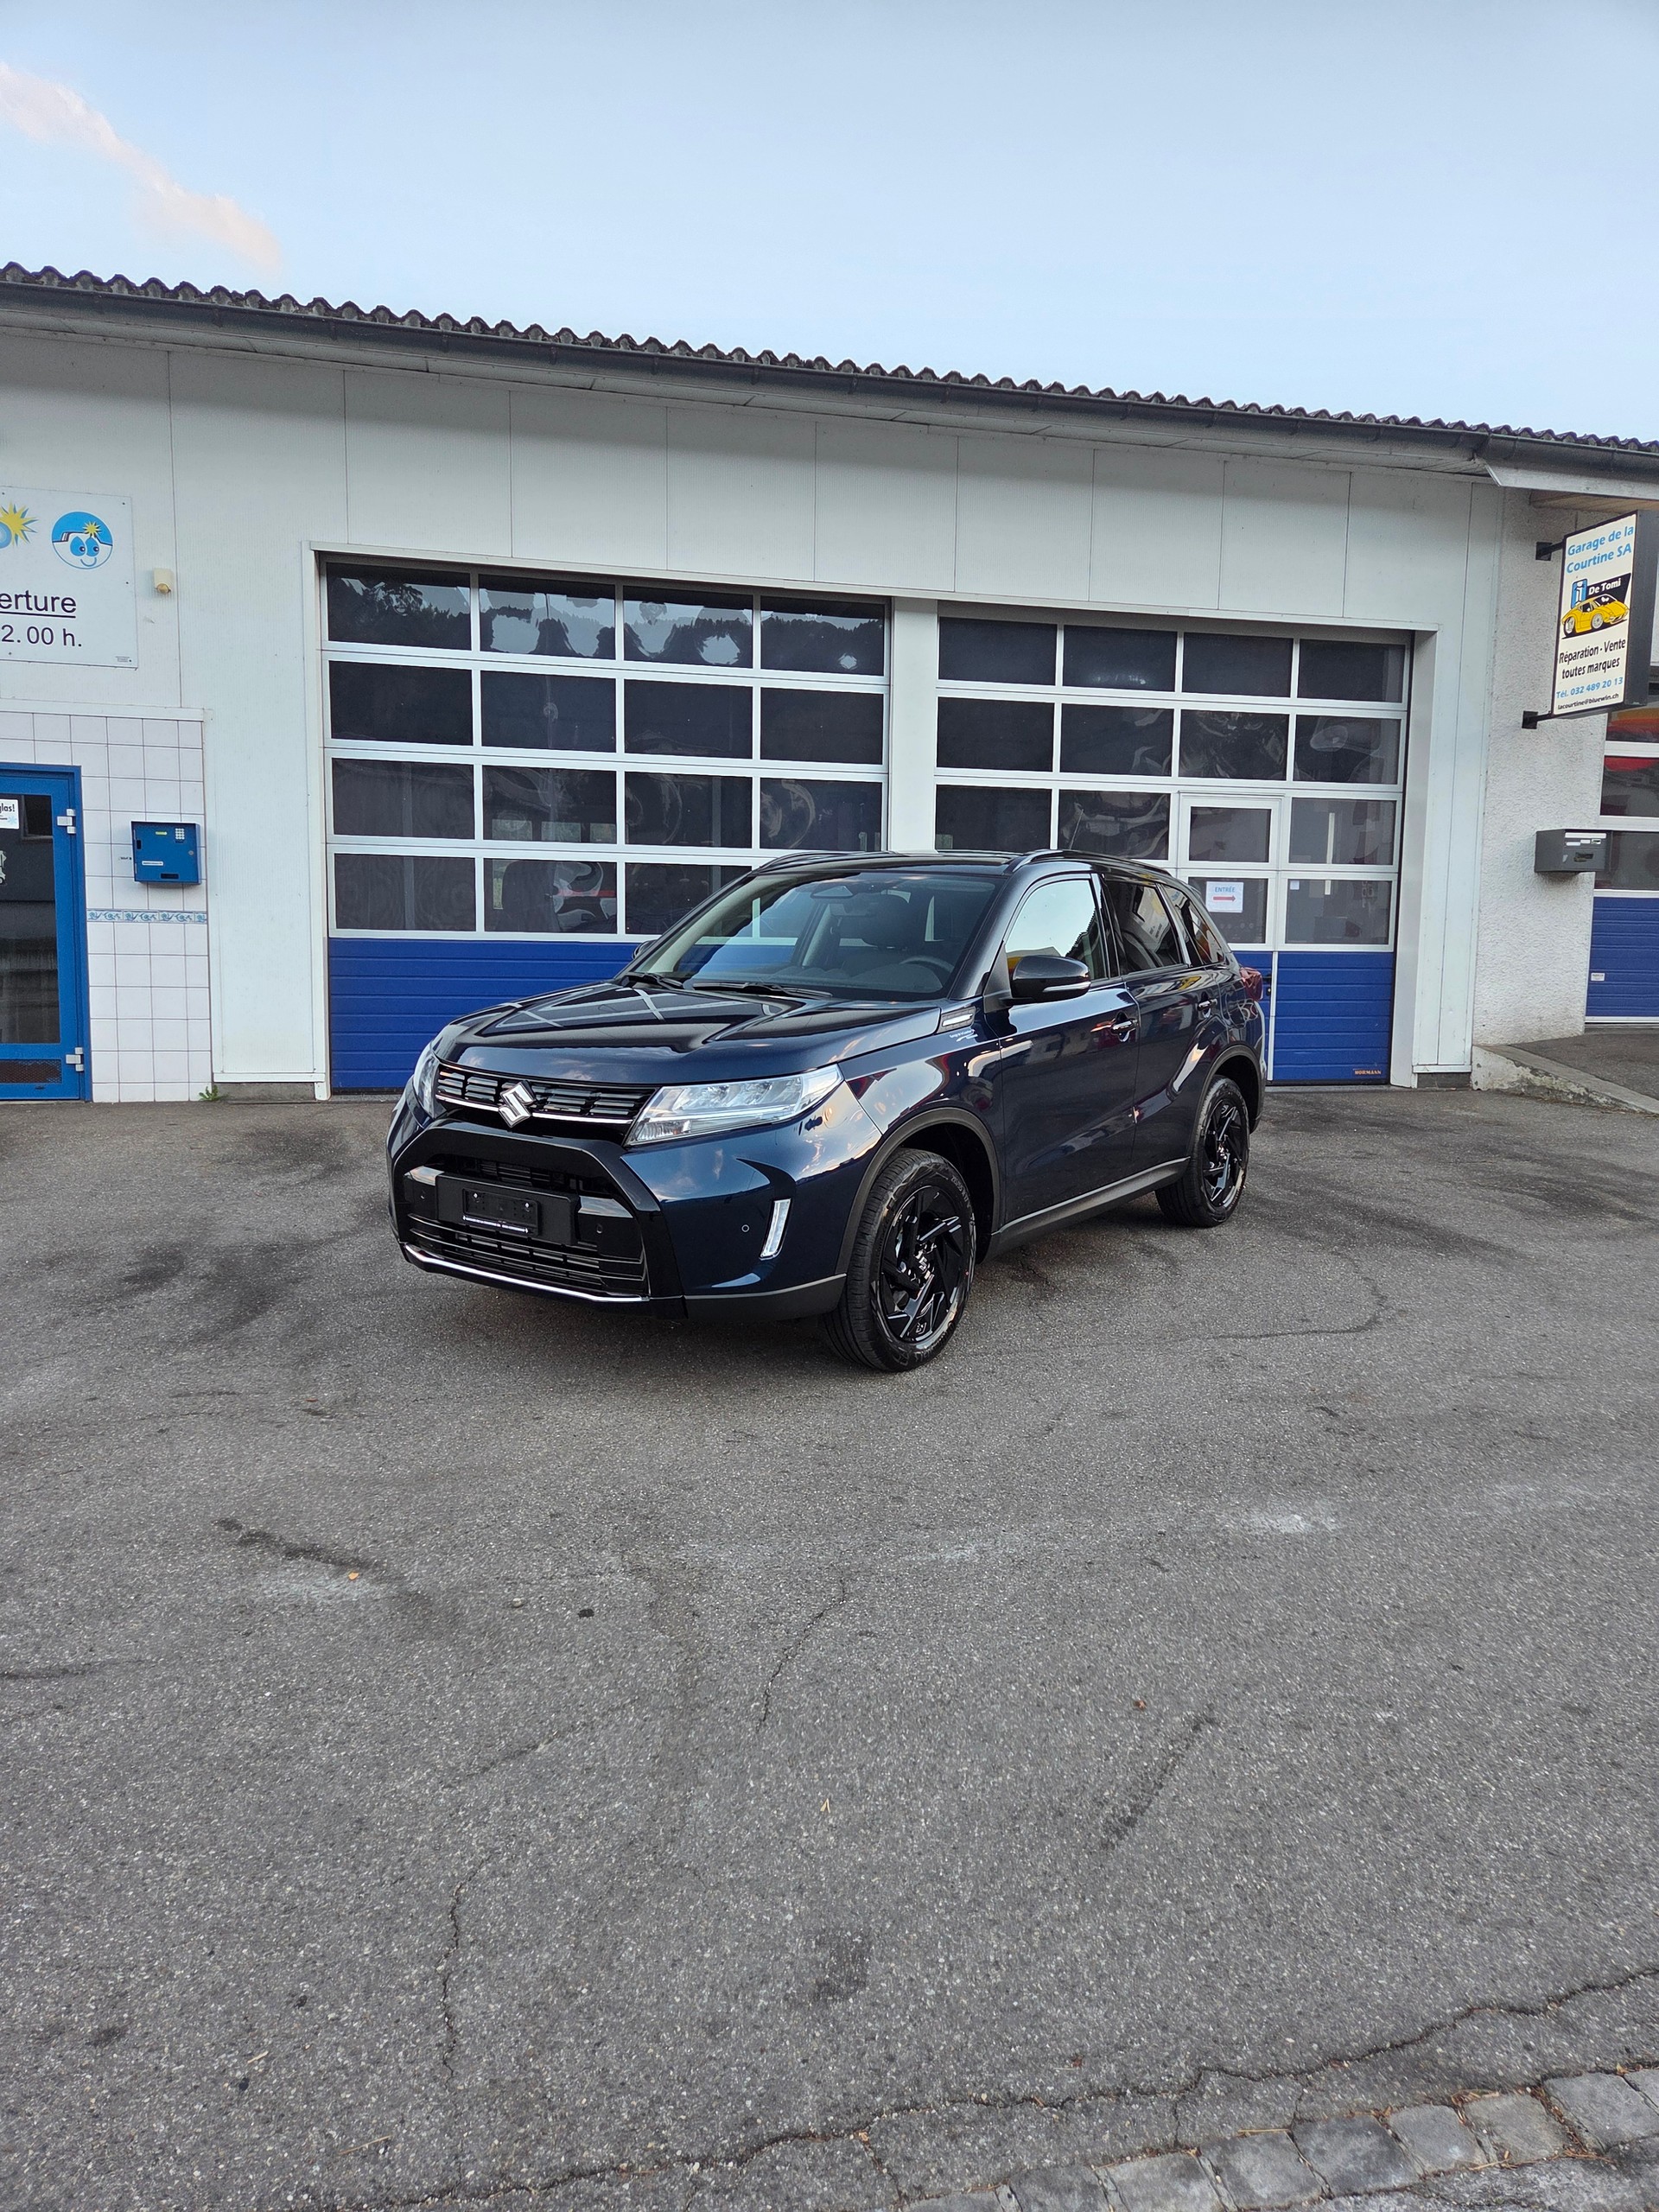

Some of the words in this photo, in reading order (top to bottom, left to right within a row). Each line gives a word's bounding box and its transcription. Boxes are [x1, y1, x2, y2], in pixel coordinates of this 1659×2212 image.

[1567, 537, 1605, 556] Garage
[1608, 531, 1621, 542] de
[1624, 526, 1634, 537] la
[1567, 551, 1614, 573] Courtine
[1617, 543, 1631, 557] SA
[1588, 586, 1599, 595] De
[1601, 578, 1621, 592] Tomi
[0, 590, 76, 613] erture
[1559, 645, 1599, 664] Réparation
[1604, 639, 1625, 652] Vente
[1561, 665, 1586, 679] toutes
[1586, 658, 1620, 673] marques
[1570, 686, 1584, 696] 032
[1586, 682, 1600, 691] 489
[1602, 679, 1611, 688] 20
[1614, 677, 1623, 685] 13
